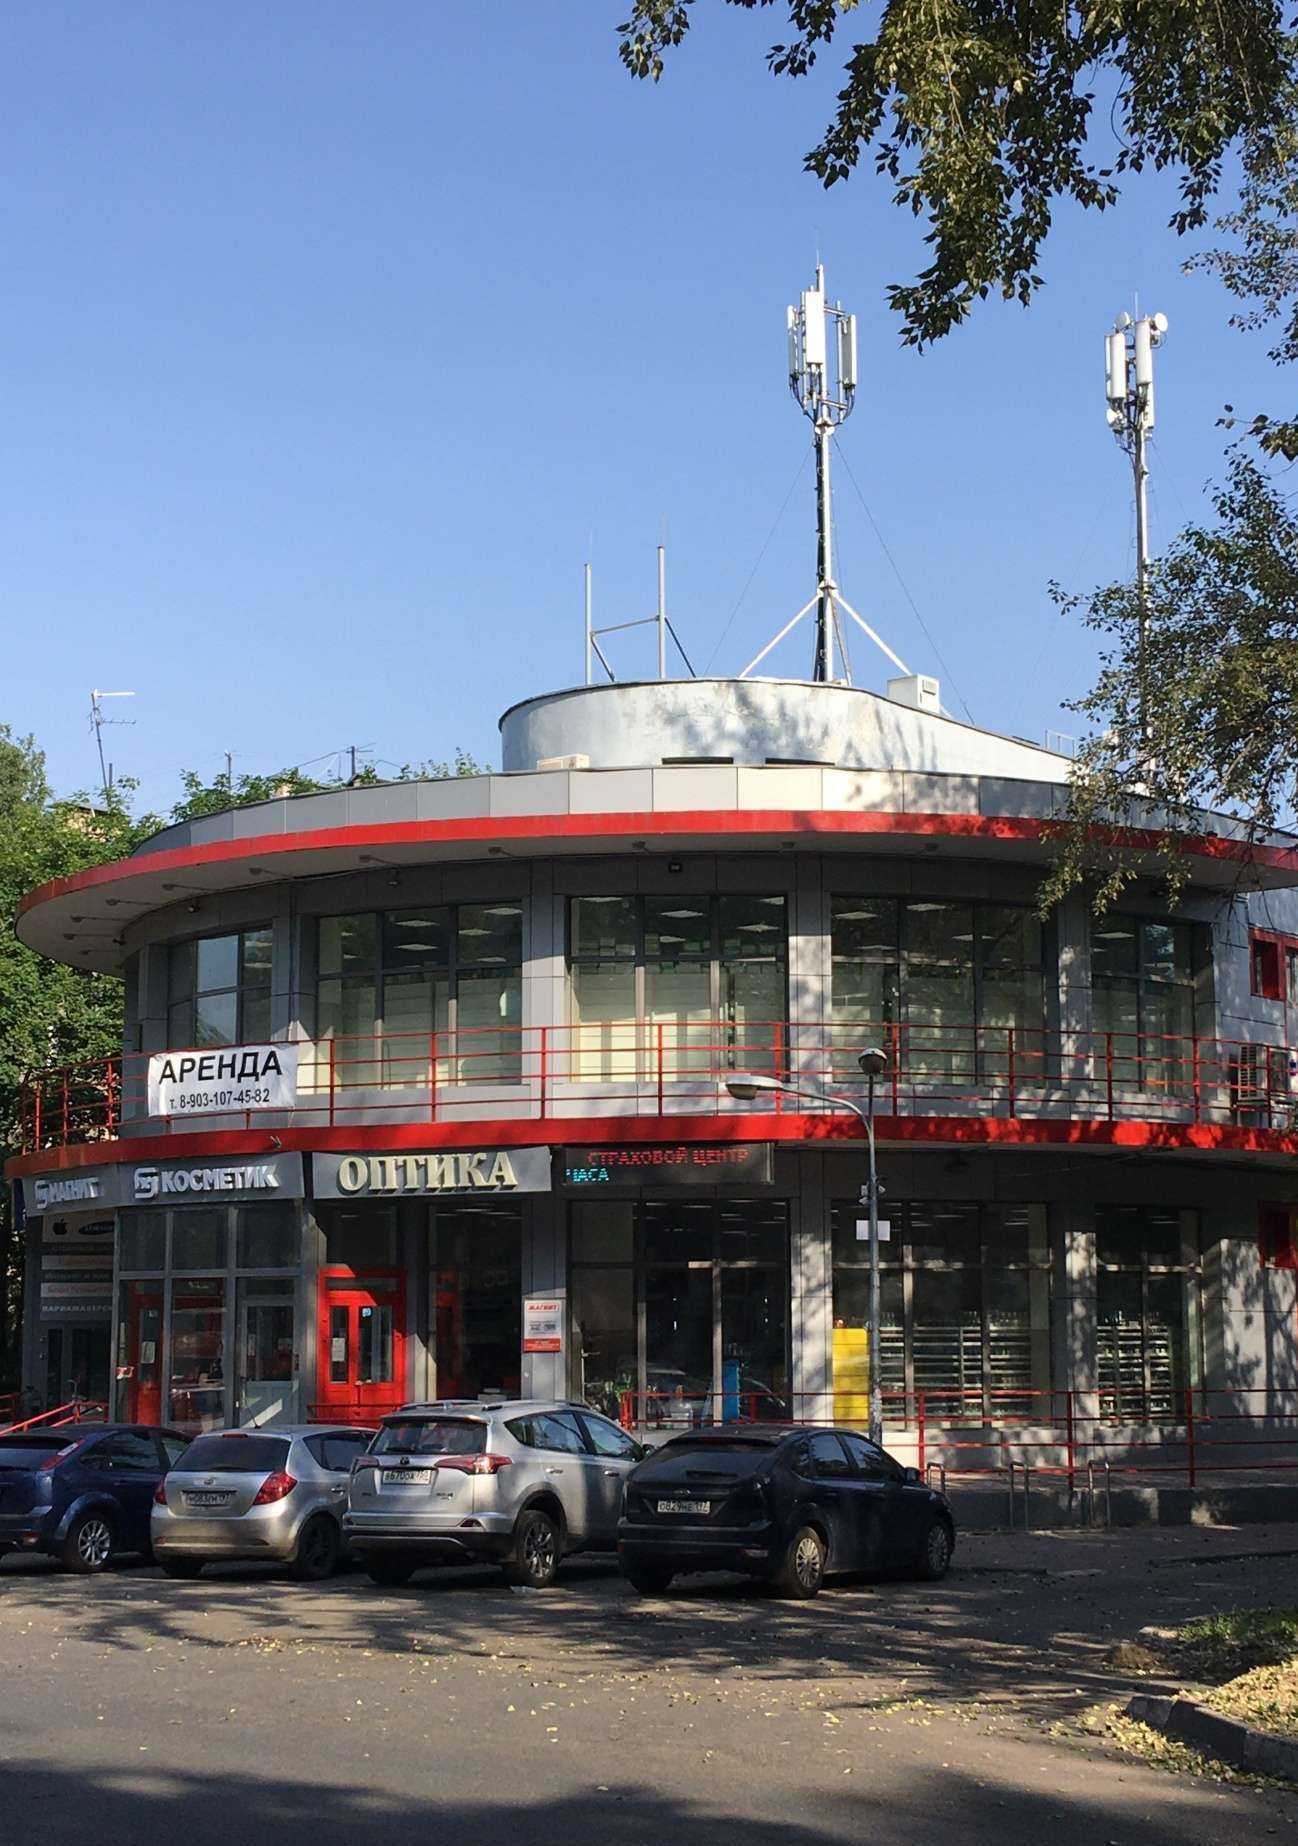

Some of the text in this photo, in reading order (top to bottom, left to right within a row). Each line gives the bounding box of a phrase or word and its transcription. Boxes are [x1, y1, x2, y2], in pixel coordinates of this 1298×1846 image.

[158, 1050, 282, 1085] АРЕНДА
[169, 1088, 270, 1109] т. 8-903-107-45-82
[587, 1147, 749, 1167] СТРАХОВОЙ ЦЕНТР
[160, 1165, 280, 1193] КОСМЕТИК
[338, 1151, 519, 1192] ОПТИКА
[48, 1177, 103, 1203] МАГНИТ
